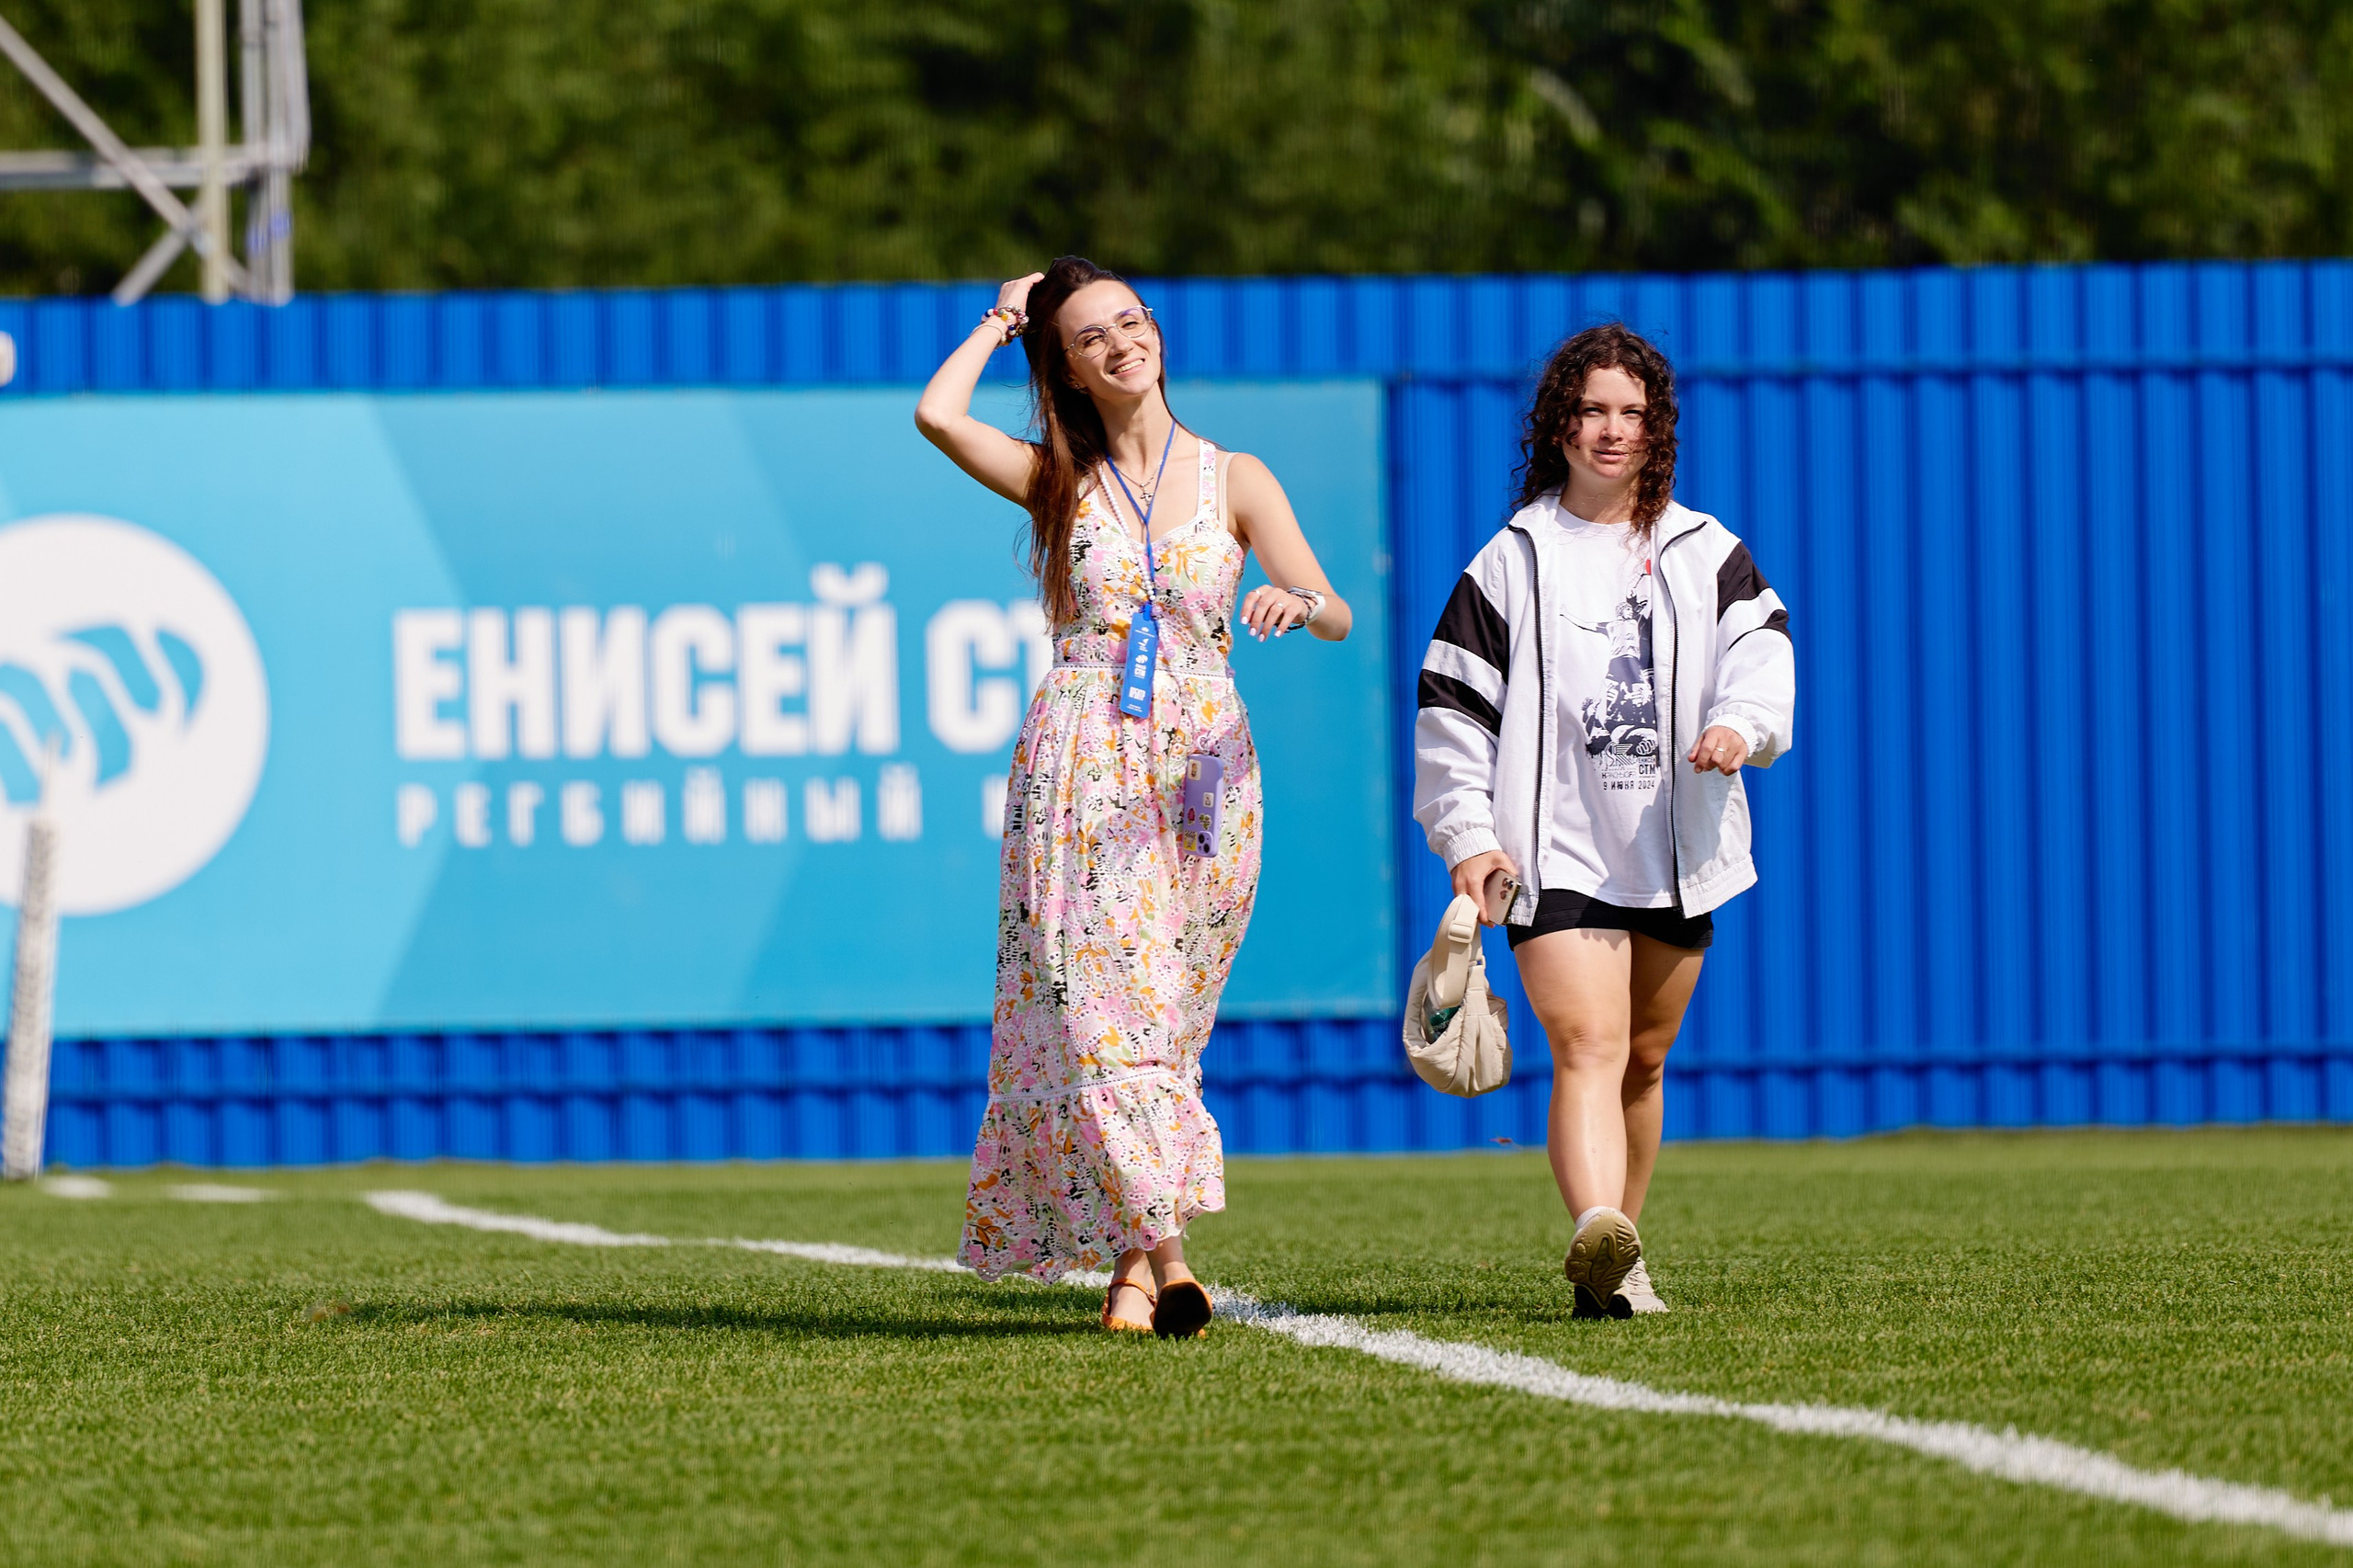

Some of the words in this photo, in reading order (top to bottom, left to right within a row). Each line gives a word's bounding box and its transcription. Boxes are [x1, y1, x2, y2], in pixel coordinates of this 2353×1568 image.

[393, 562, 899, 760] ЕНИСЕЙ
[1603, 781, 1608, 790] 9
[1610, 780, 1634, 790] ИЮНЯ
[1638, 780, 1655, 790] 2024
[1639, 765, 1655, 775] СТМ
[397, 763, 923, 847] РЕГБИЙНЫЙ
